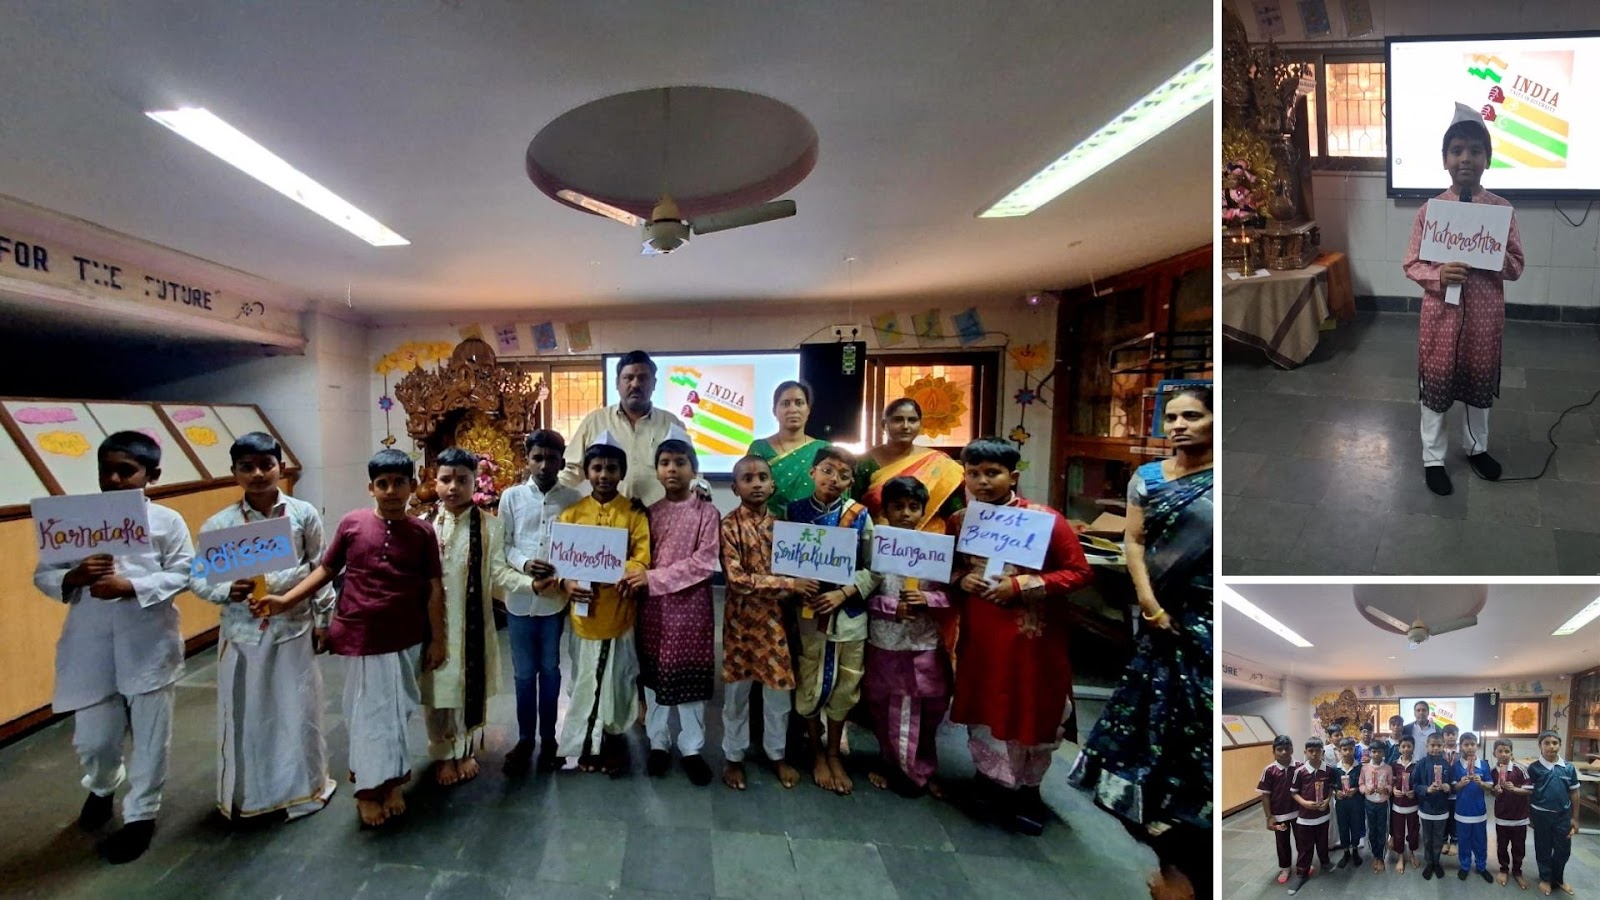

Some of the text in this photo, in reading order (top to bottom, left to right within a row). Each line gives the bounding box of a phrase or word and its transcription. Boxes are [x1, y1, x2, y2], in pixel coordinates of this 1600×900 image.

[1512, 75, 1559, 107] INDIA
[1423, 220, 1502, 254] Maharashtra
[0, 235, 50, 272] FOR
[706, 382, 744, 407] INDIA
[40, 517, 150, 550] Karnataka
[979, 509, 1028, 527] West
[875, 535, 946, 567] Telangana
[961, 524, 1035, 552] Bengal
[550, 541, 622, 570] Maharashtra
